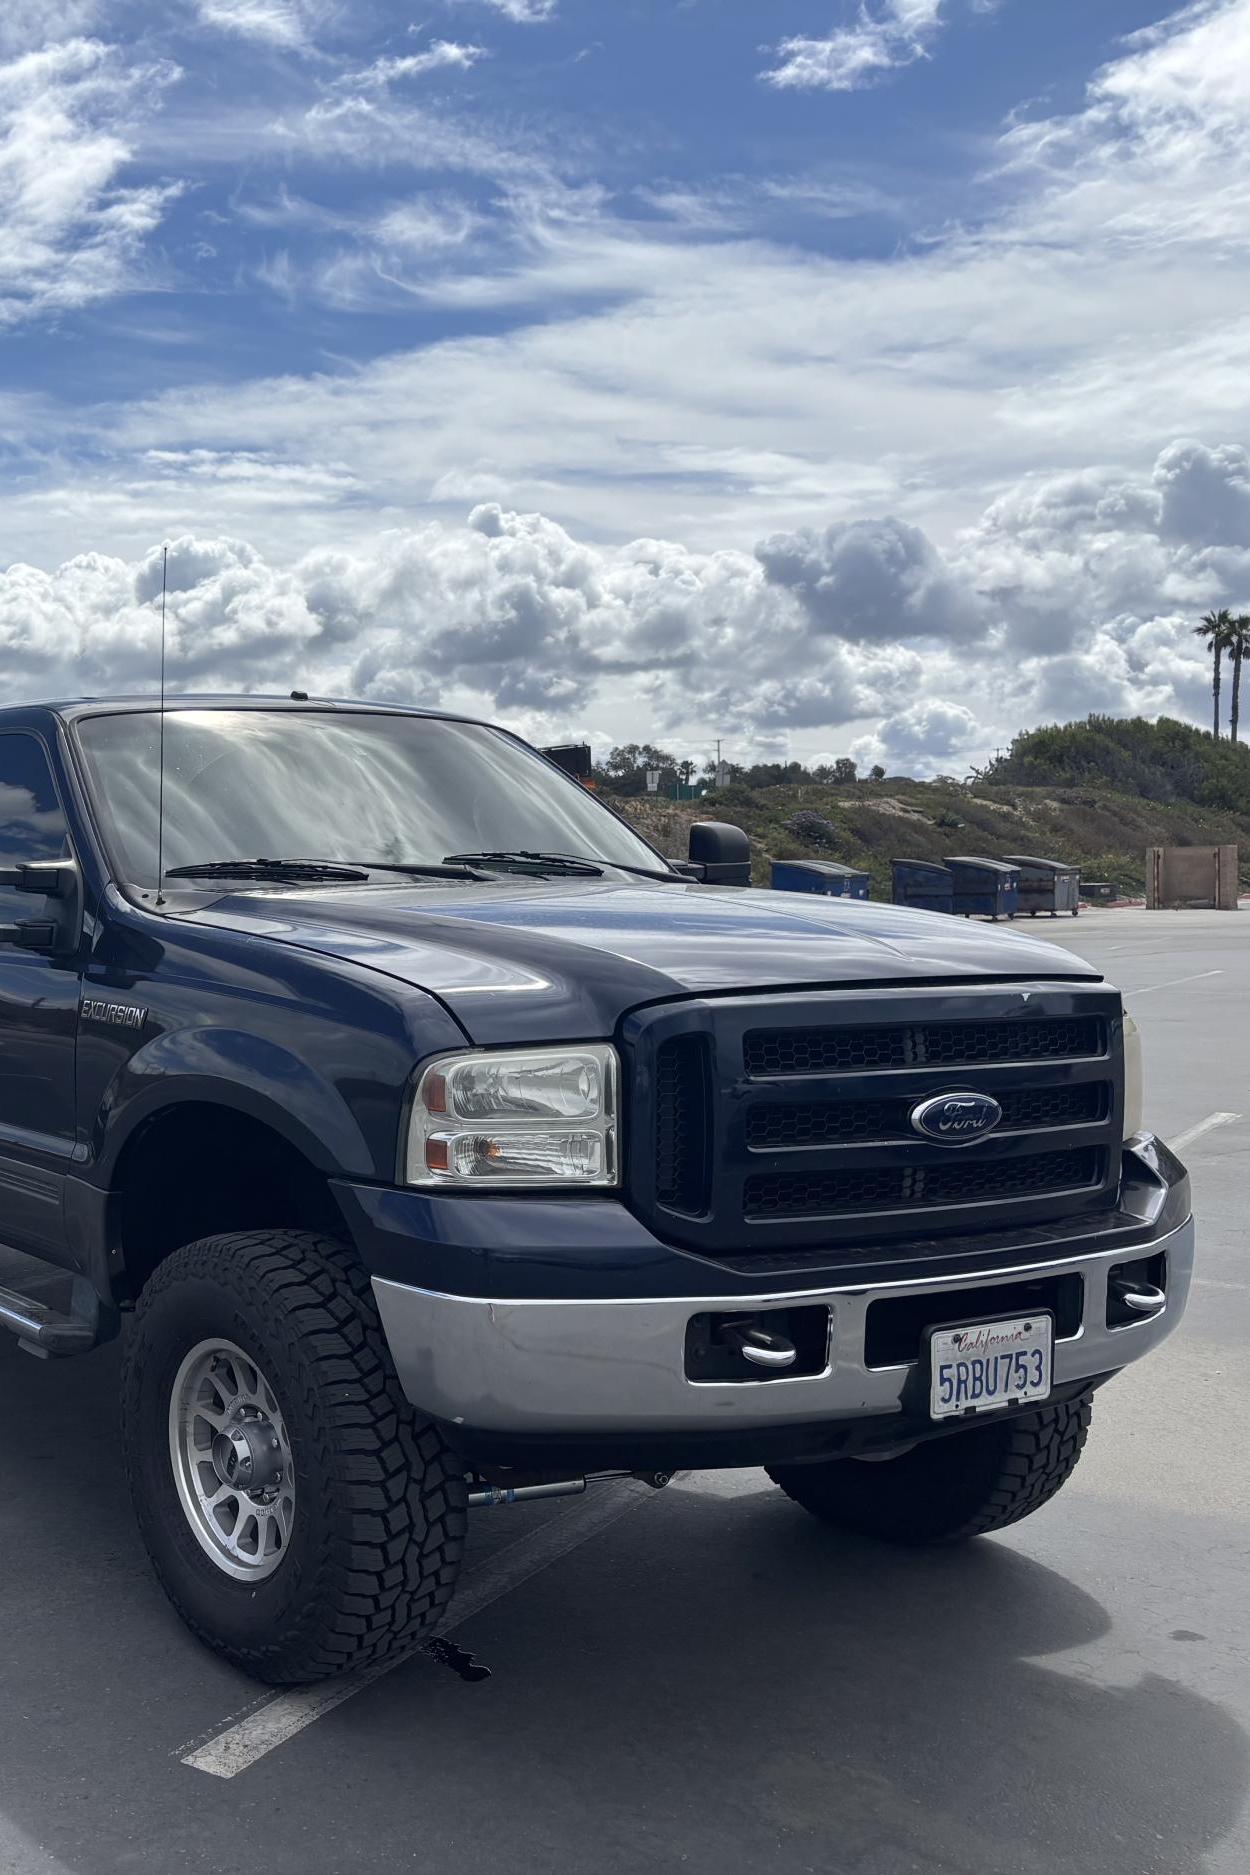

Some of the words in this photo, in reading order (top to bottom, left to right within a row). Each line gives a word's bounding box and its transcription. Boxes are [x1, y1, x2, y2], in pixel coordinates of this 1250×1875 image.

[80, 1000, 145, 1028] EXCURSION
[939, 1101, 989, 1131] Ford
[957, 1328, 1031, 1354] California
[939, 1348, 1043, 1404] 5RBU753
